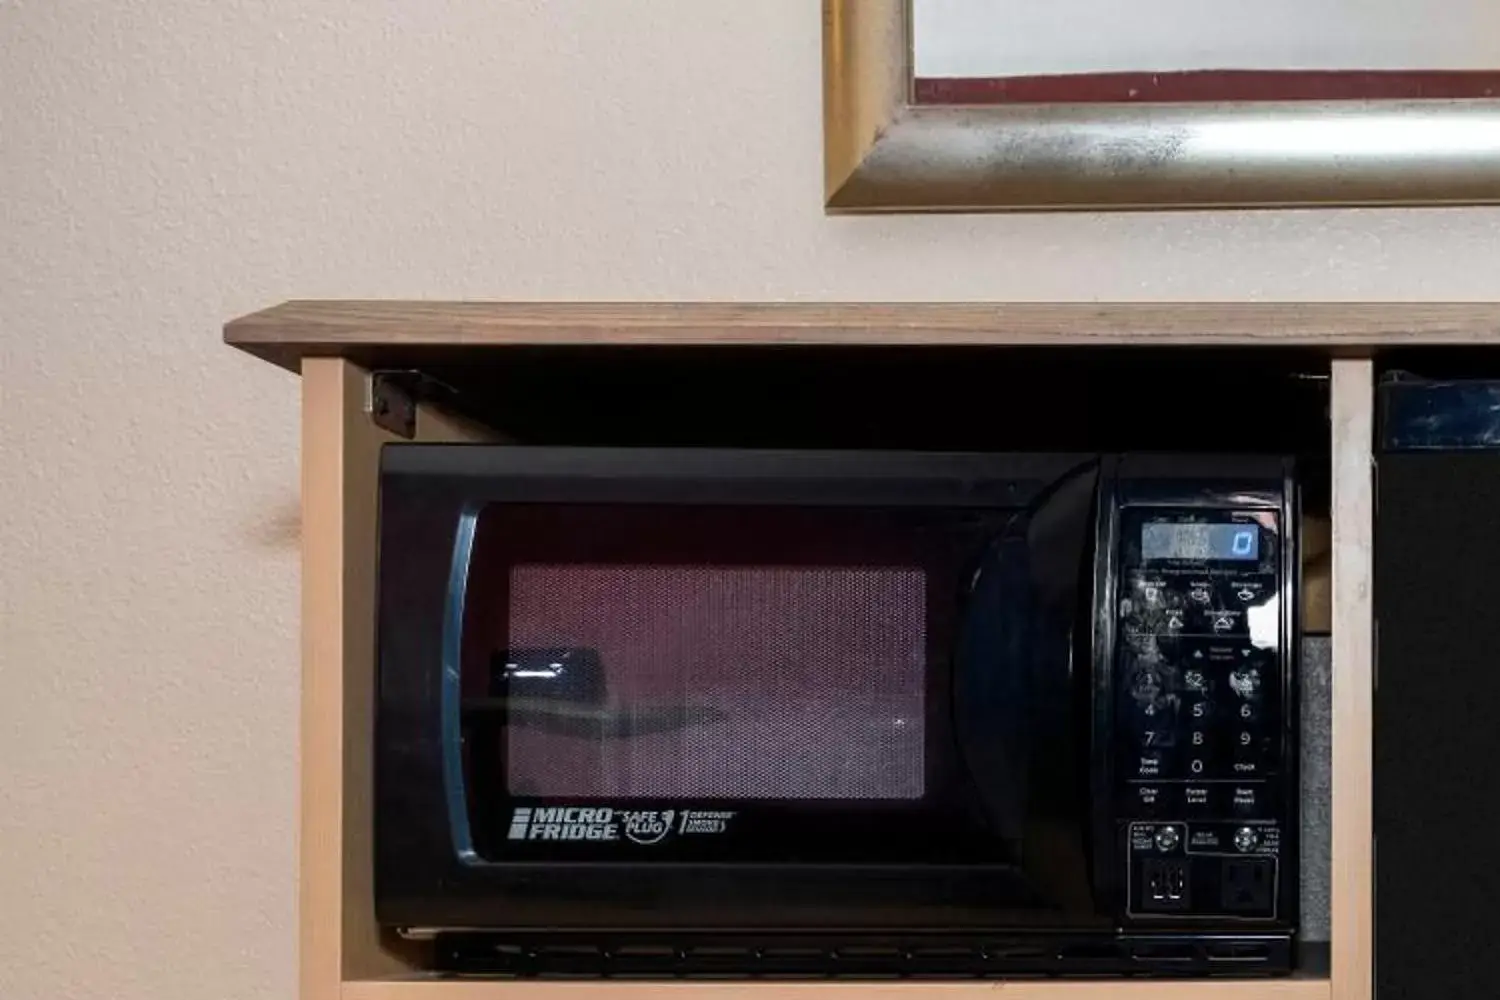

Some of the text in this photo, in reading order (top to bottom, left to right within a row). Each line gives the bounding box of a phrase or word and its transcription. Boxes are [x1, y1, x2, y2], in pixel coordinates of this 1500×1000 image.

[1231, 531, 1253, 555] 0
[1144, 704, 1155, 717] 4
[1193, 704, 1204, 717] 5
[1240, 704, 1251, 717] 6
[1145, 732, 1156, 746] 7
[1193, 732, 1204, 745] 8
[1240, 731, 1251, 745] 9
[1191, 759, 1203, 773] 0
[533, 807, 613, 823] MICRO
[622, 811, 657, 823] SAFE
[528, 824, 618, 840] FRIDGE
[626, 822, 664, 834] PLUG
